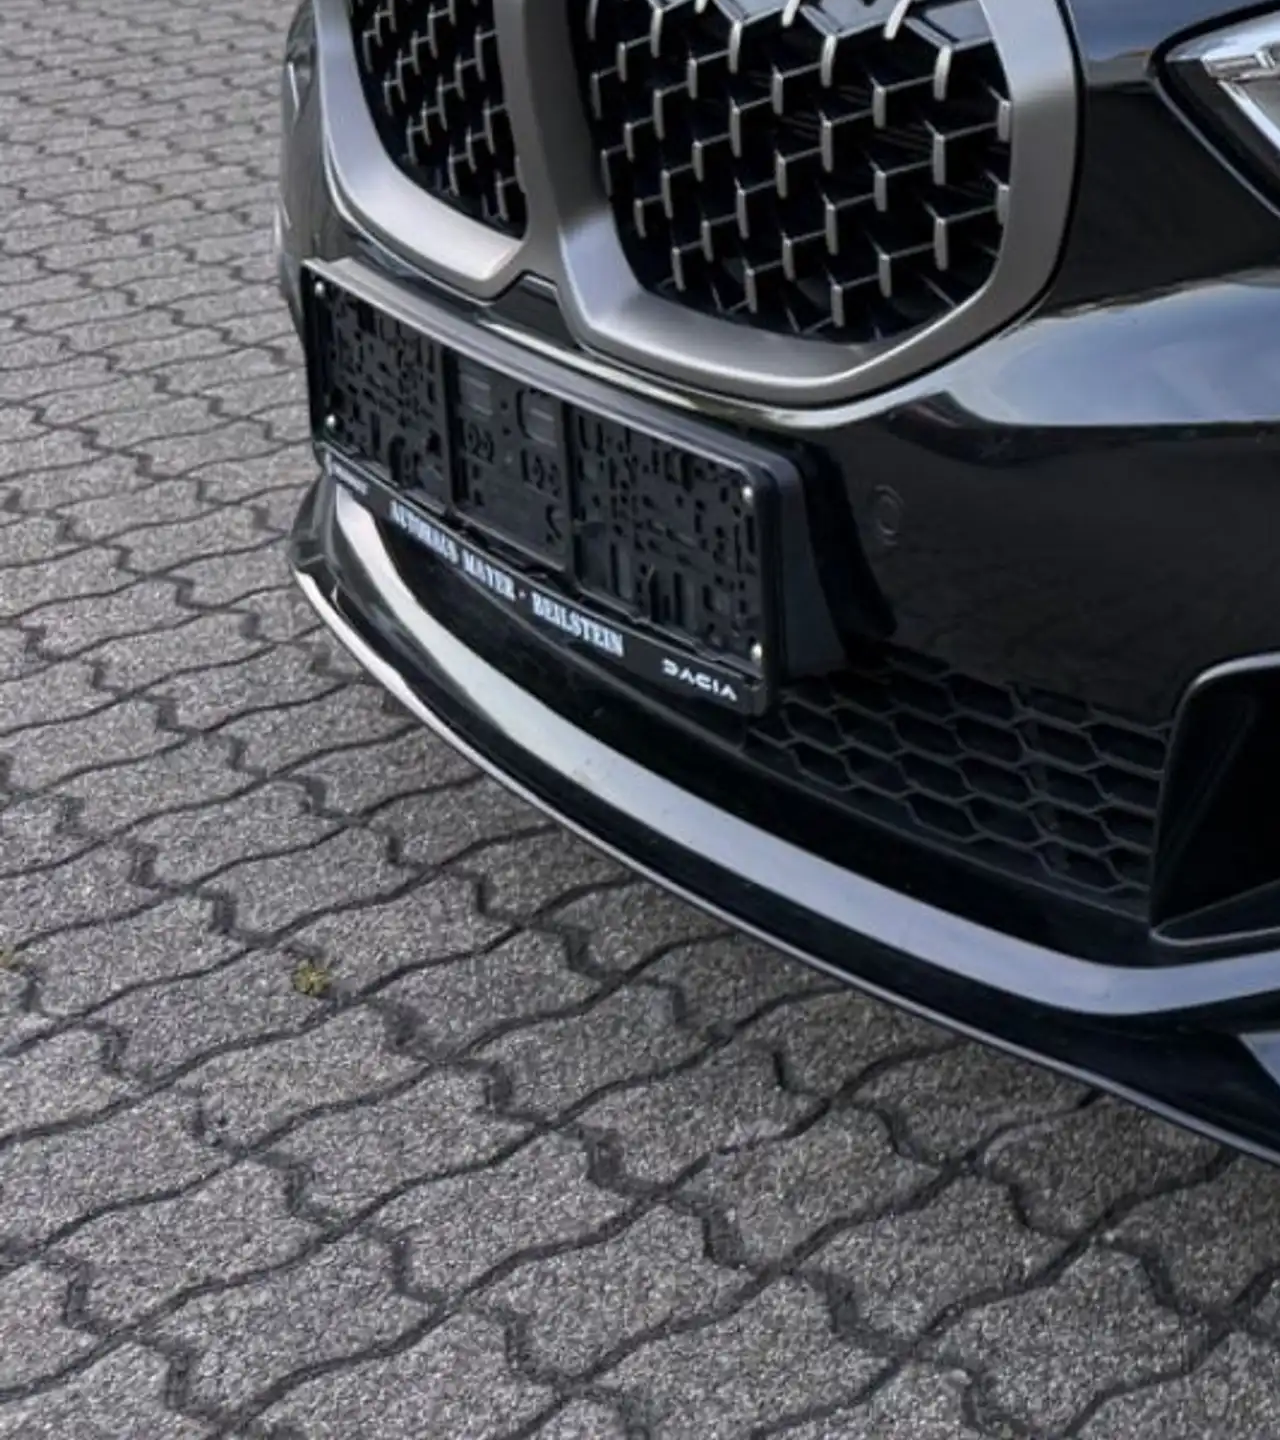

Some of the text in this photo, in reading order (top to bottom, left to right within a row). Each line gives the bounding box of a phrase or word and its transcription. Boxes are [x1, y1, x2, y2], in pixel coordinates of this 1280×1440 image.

[463, 548, 516, 602] MAYER
[532, 591, 624, 657] BEILSTEIN
[662, 658, 737, 701] DACIA
